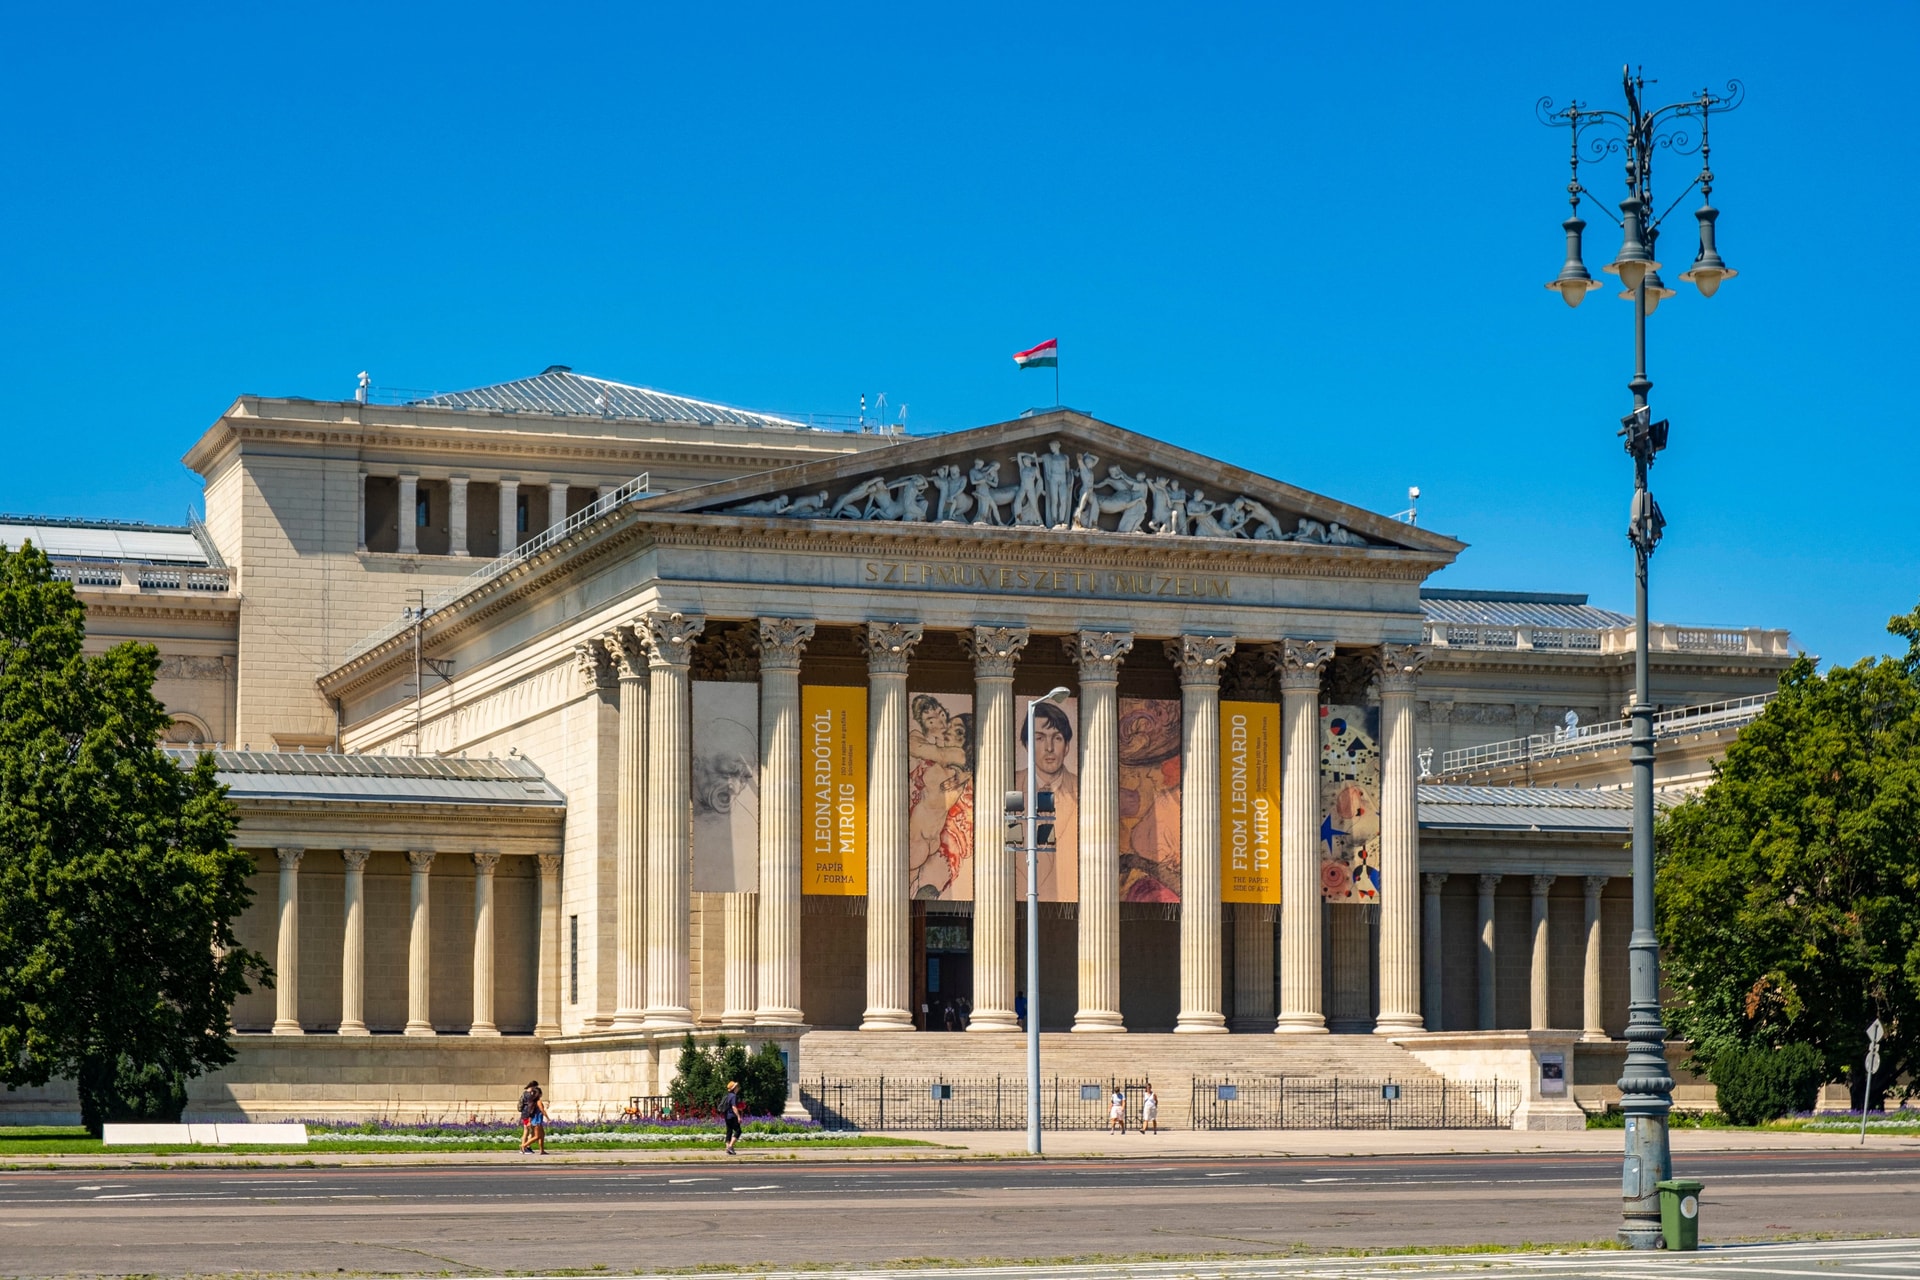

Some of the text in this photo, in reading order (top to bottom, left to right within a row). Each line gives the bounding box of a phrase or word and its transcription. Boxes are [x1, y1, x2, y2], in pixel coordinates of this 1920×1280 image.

[811, 709, 832, 854] LEONARDÓTÓL
[1231, 714, 1248, 871] FROM LEONARDO
[835, 783, 855, 854] MIRÓIG
[1251, 798, 1269, 871] TO MIRÓ
[816, 861, 843, 871] PAPÍR
[823, 874, 854, 883] FORMA
[1232, 875, 1246, 883] THE
